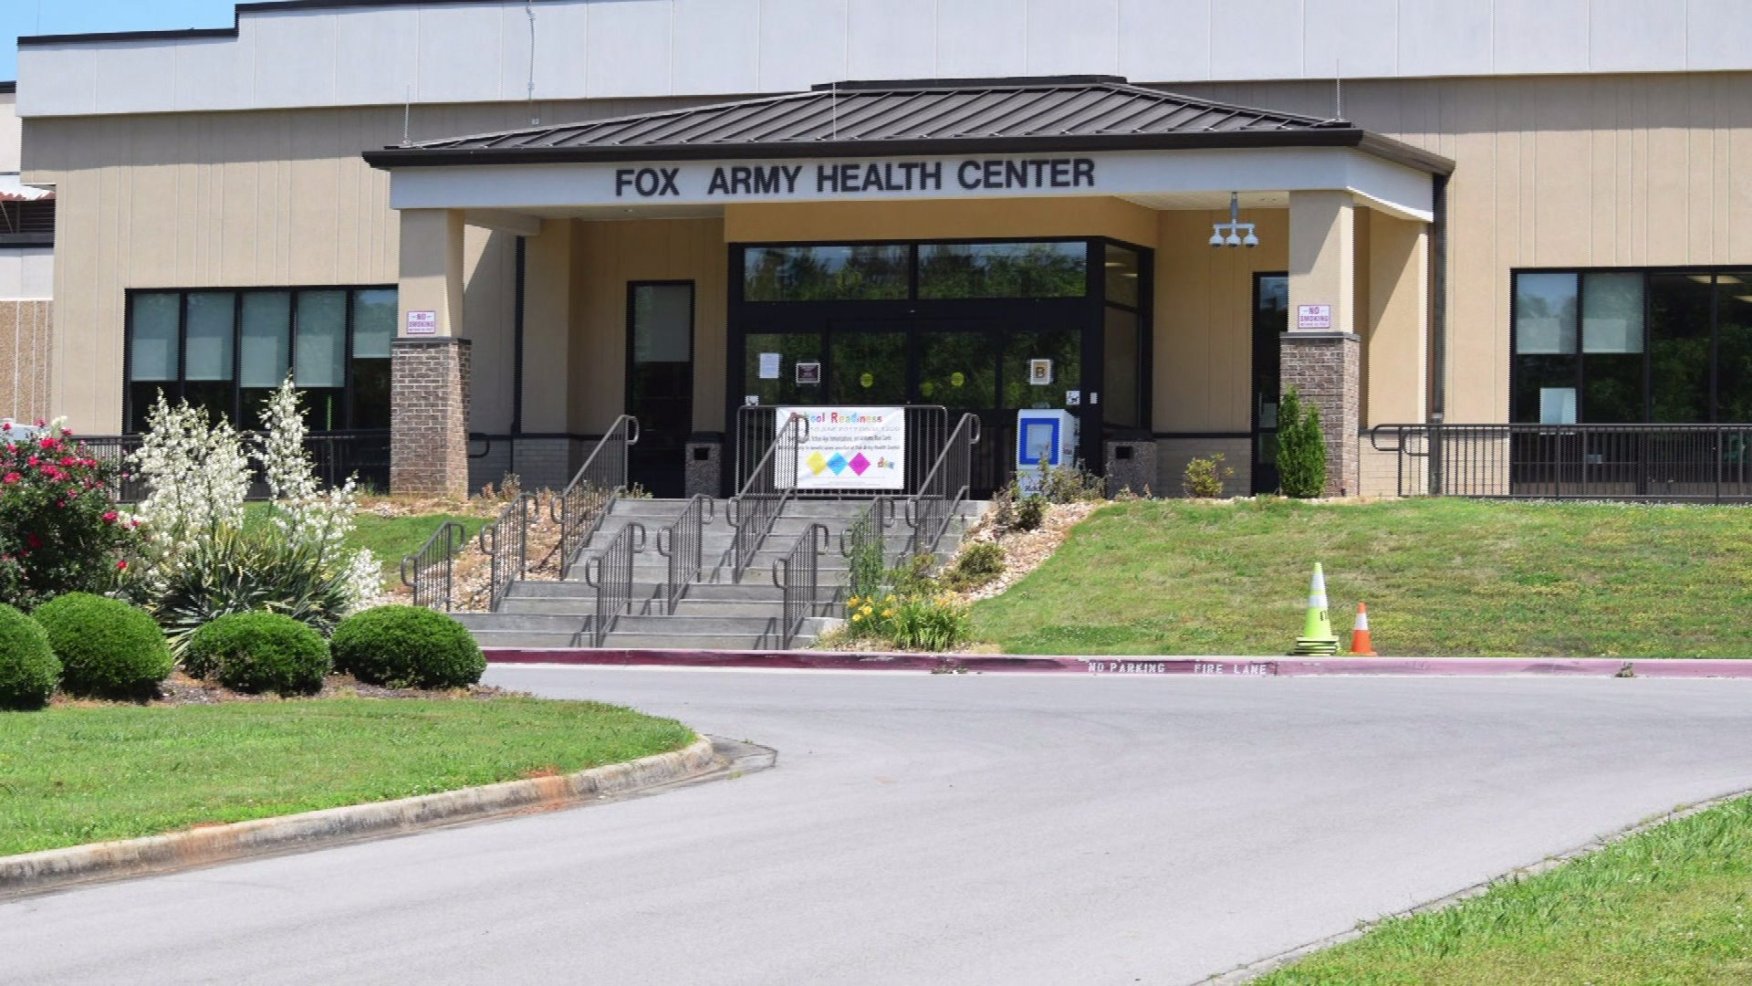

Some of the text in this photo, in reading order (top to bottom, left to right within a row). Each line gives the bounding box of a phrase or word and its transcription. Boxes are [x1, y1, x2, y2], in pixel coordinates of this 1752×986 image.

[615, 158, 1095, 197] FOX ARMY HEALTH CENTER
[831, 411, 883, 424] Readiness
[1088, 662, 1267, 676] NO PARKING FIRE LANE
